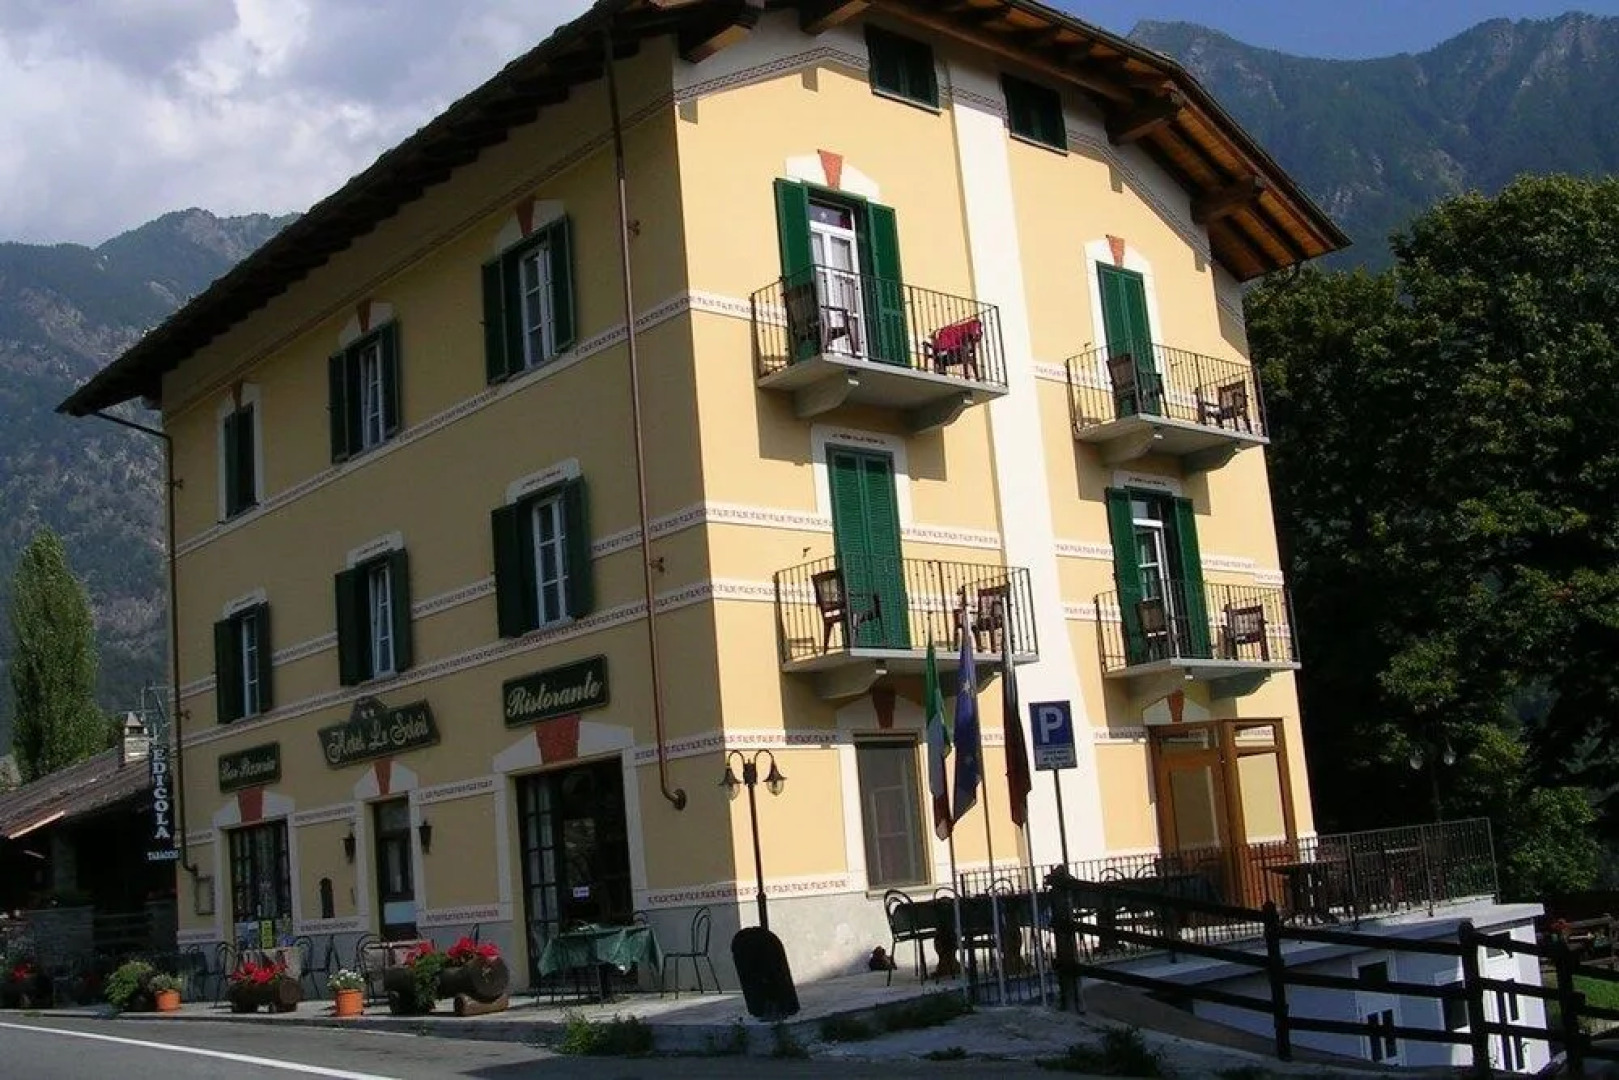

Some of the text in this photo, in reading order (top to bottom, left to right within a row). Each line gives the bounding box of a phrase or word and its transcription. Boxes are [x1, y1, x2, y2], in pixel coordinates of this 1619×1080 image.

[507, 671, 602, 716] Ristorante
[1039, 706, 1063, 743] P
[152, 749, 170, 839] EDICOLA
